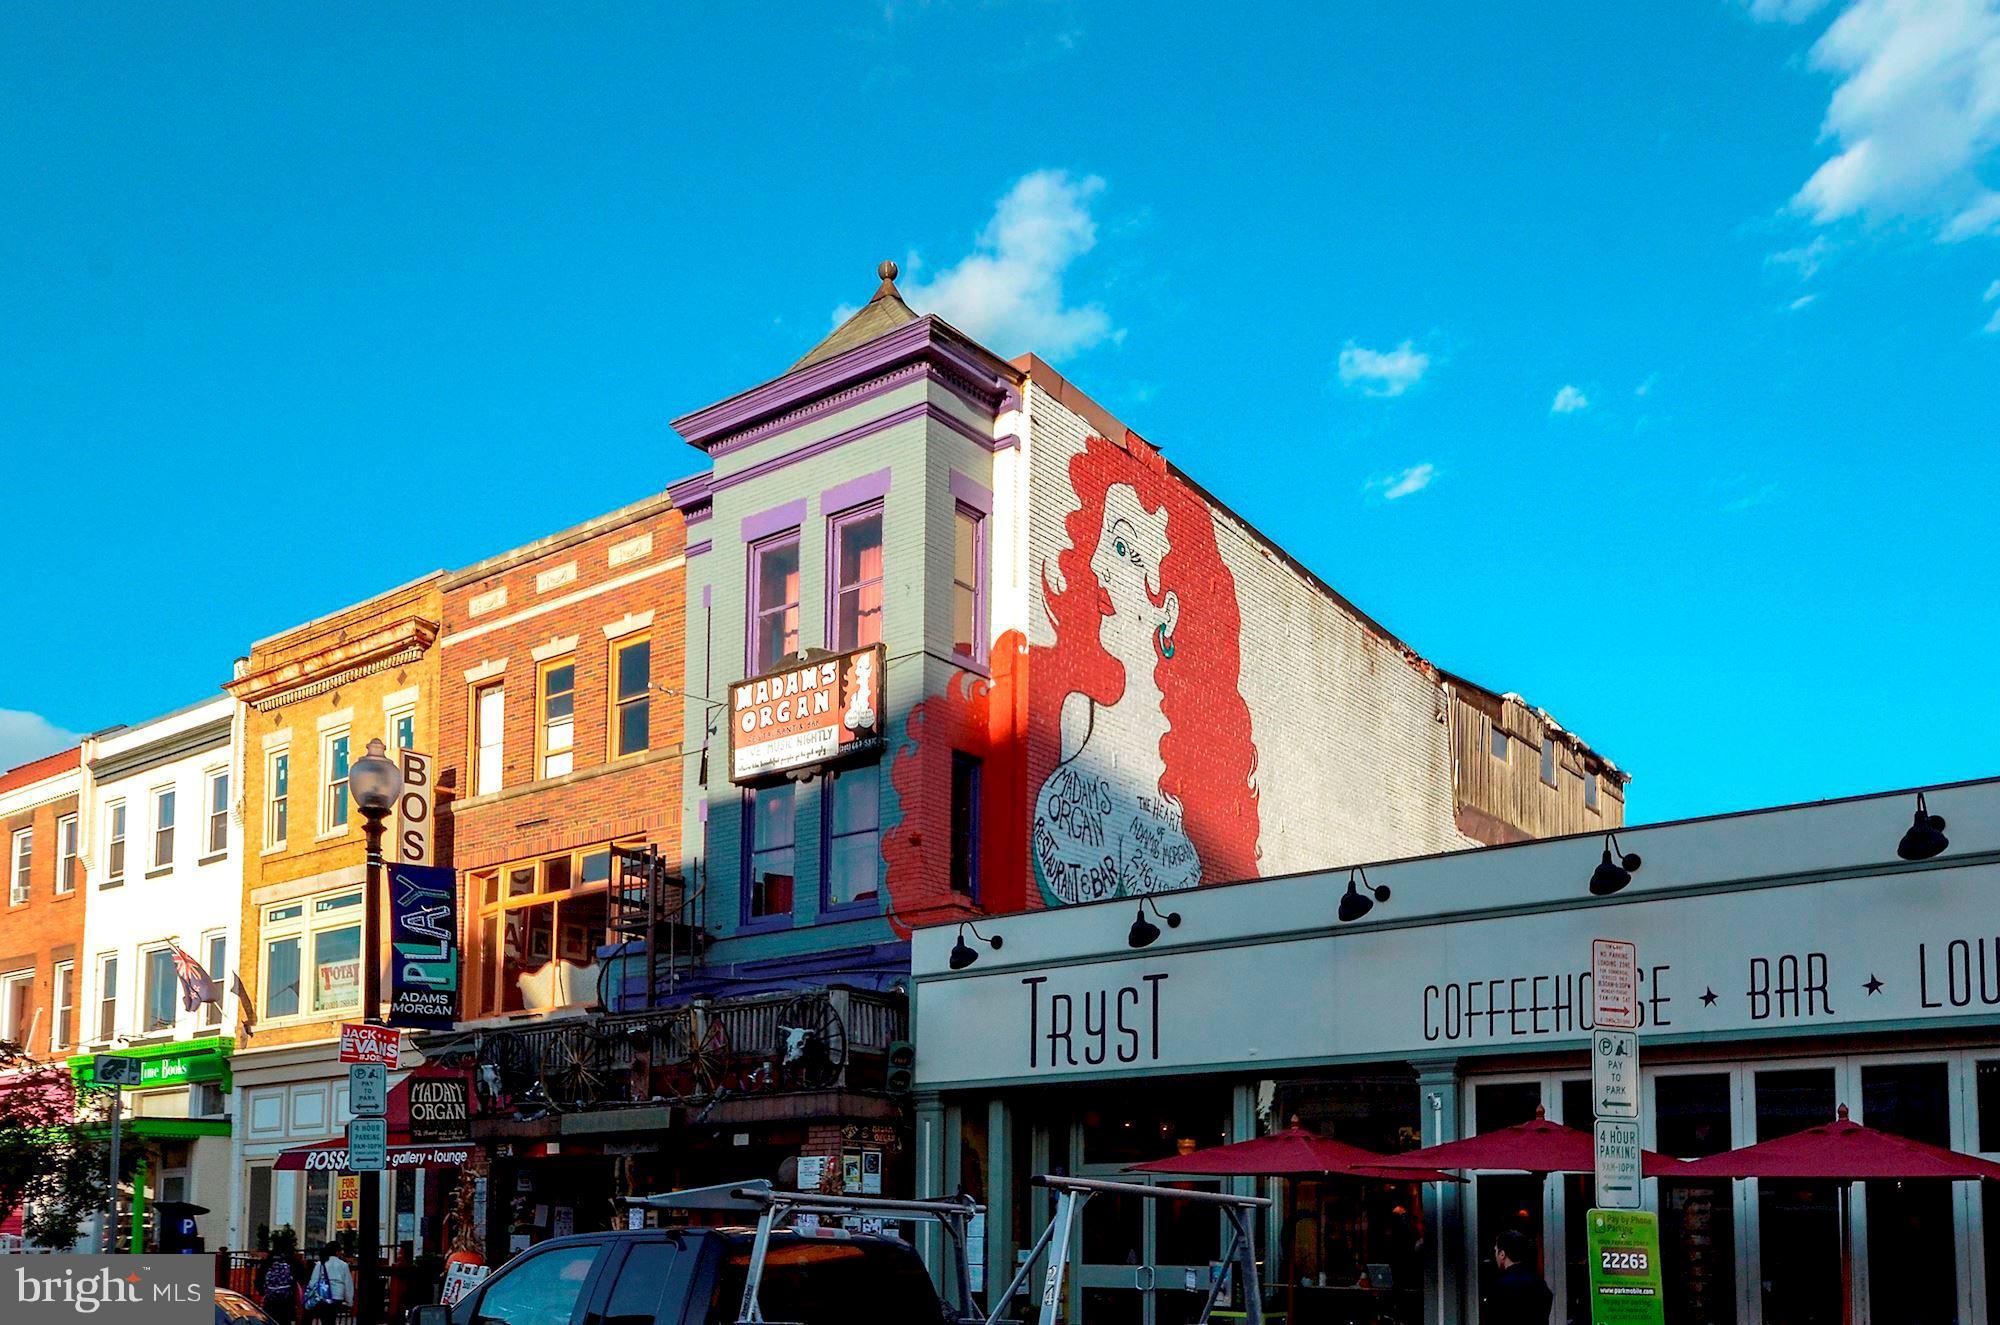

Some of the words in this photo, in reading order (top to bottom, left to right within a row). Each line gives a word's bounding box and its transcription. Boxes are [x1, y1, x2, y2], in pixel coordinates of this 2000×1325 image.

[736, 661, 838, 712] MADAM'S
[741, 689, 830, 734] ORGAN
[748, 725, 798, 742] RESTARANT
[797, 728, 833, 746] NIGHTLY
[1050, 768, 1111, 815] MADAM'S
[1048, 794, 1104, 847] ORGAN
[1137, 796, 1151, 813] THE
[1153, 797, 1183, 832] HEART
[1090, 856, 1119, 898] BAR
[396, 874, 452, 983] PLAY
[399, 992, 448, 1004] ADAMS
[1424, 965, 1672, 1041] COFFEEHOE
[1747, 953, 1835, 1020] BAR
[392, 1003, 452, 1015] MORGAN
[1022, 973, 1169, 1068] TRYST
[343, 1028, 377, 1040] JACK
[342, 1038, 398, 1058] EVANS
[161, 1058, 187, 1079] Books
[1608, 1060, 1623, 1069] PAY
[1606, 1086, 1626, 1094] PARK
[411, 1103, 466, 1120] ORGAN
[1600, 1130, 1606, 1143] 4
[1610, 1130, 1636, 1144] HOUR
[392, 1151, 426, 1167] gallery
[433, 1150, 468, 1166] lounge
[1600, 1145, 1636, 1159] PARKING
[342, 1178, 355, 1188] FOR
[338, 1189, 358, 1200] LEASE
[1608, 1215, 1619, 1225] Pay
[1621, 1216, 1629, 1225] by
[1602, 1252, 1648, 1270] 22263
